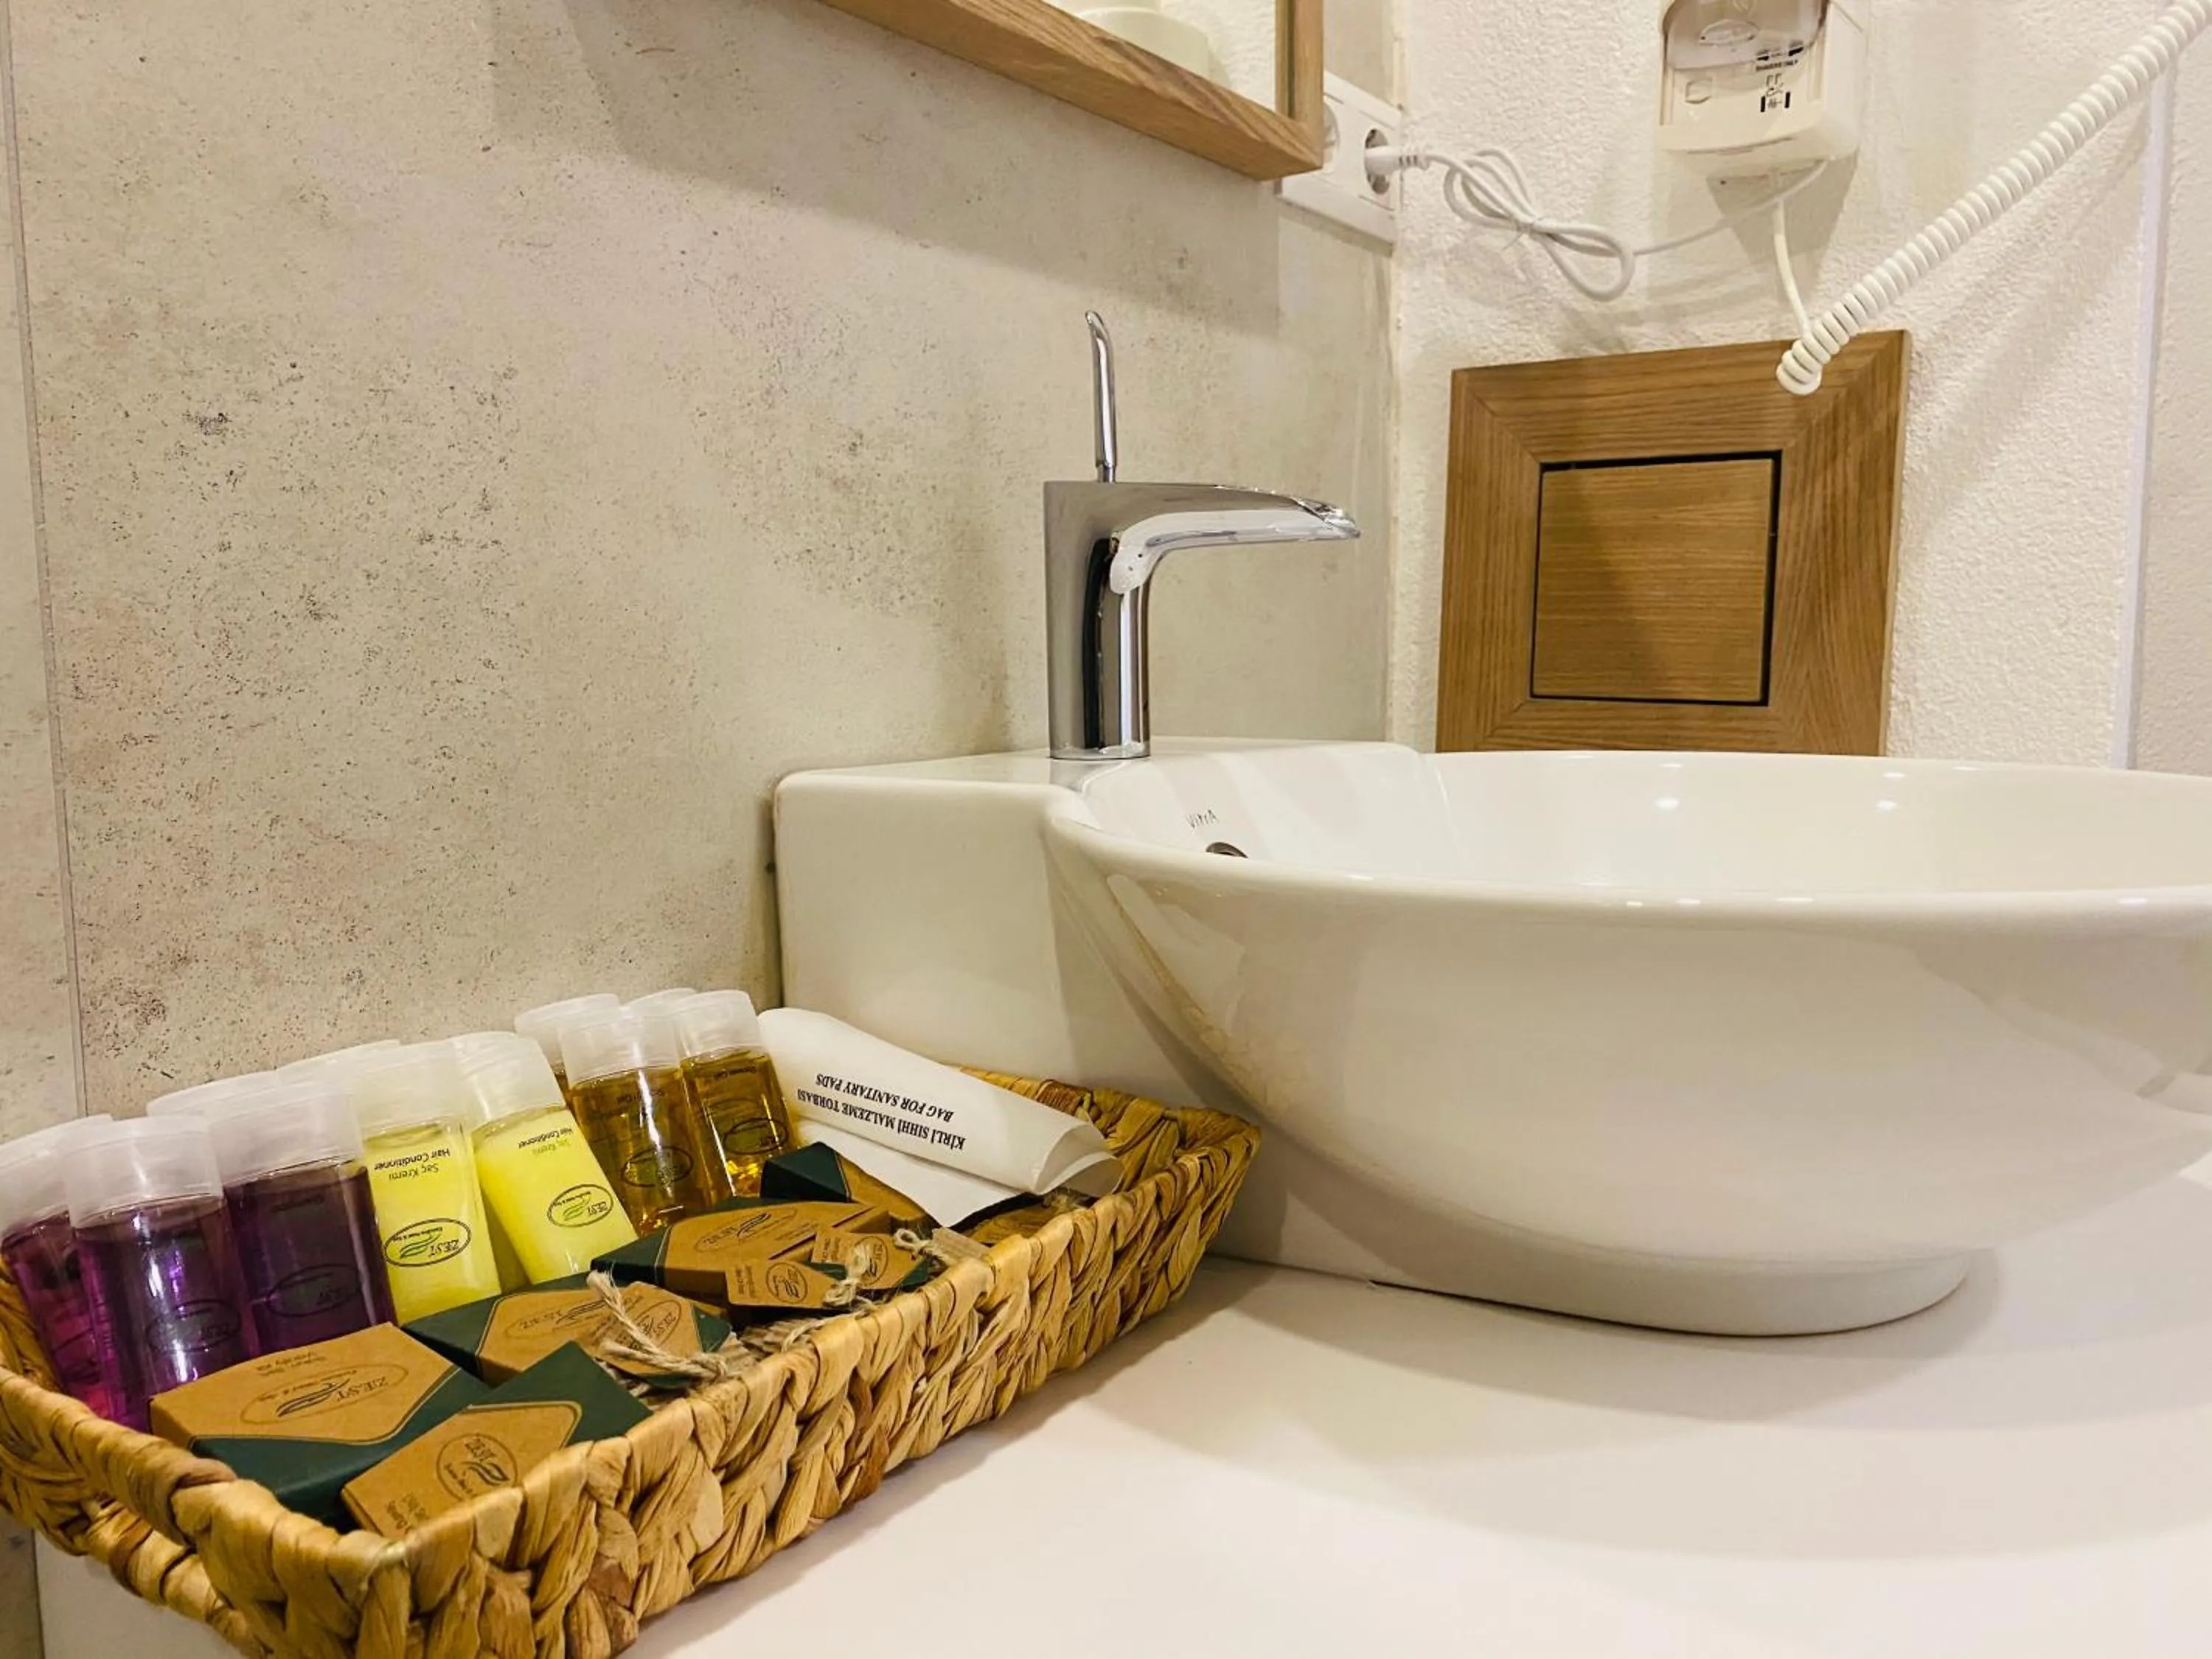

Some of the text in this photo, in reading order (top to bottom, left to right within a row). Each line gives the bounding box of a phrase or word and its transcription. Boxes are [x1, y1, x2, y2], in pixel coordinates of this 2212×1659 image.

[815, 1073, 955, 1122] BAG FOR SANITARY PADS
[797, 1088, 967, 1150] KİRLİ SIHHİ MALZEME TORBASI
[373, 1147, 451, 1172] Hair Conditioner
[388, 1162, 439, 1182] Saç Kremi
[428, 1239, 461, 1257] ZEST
[336, 1375, 390, 1402] ZEST
